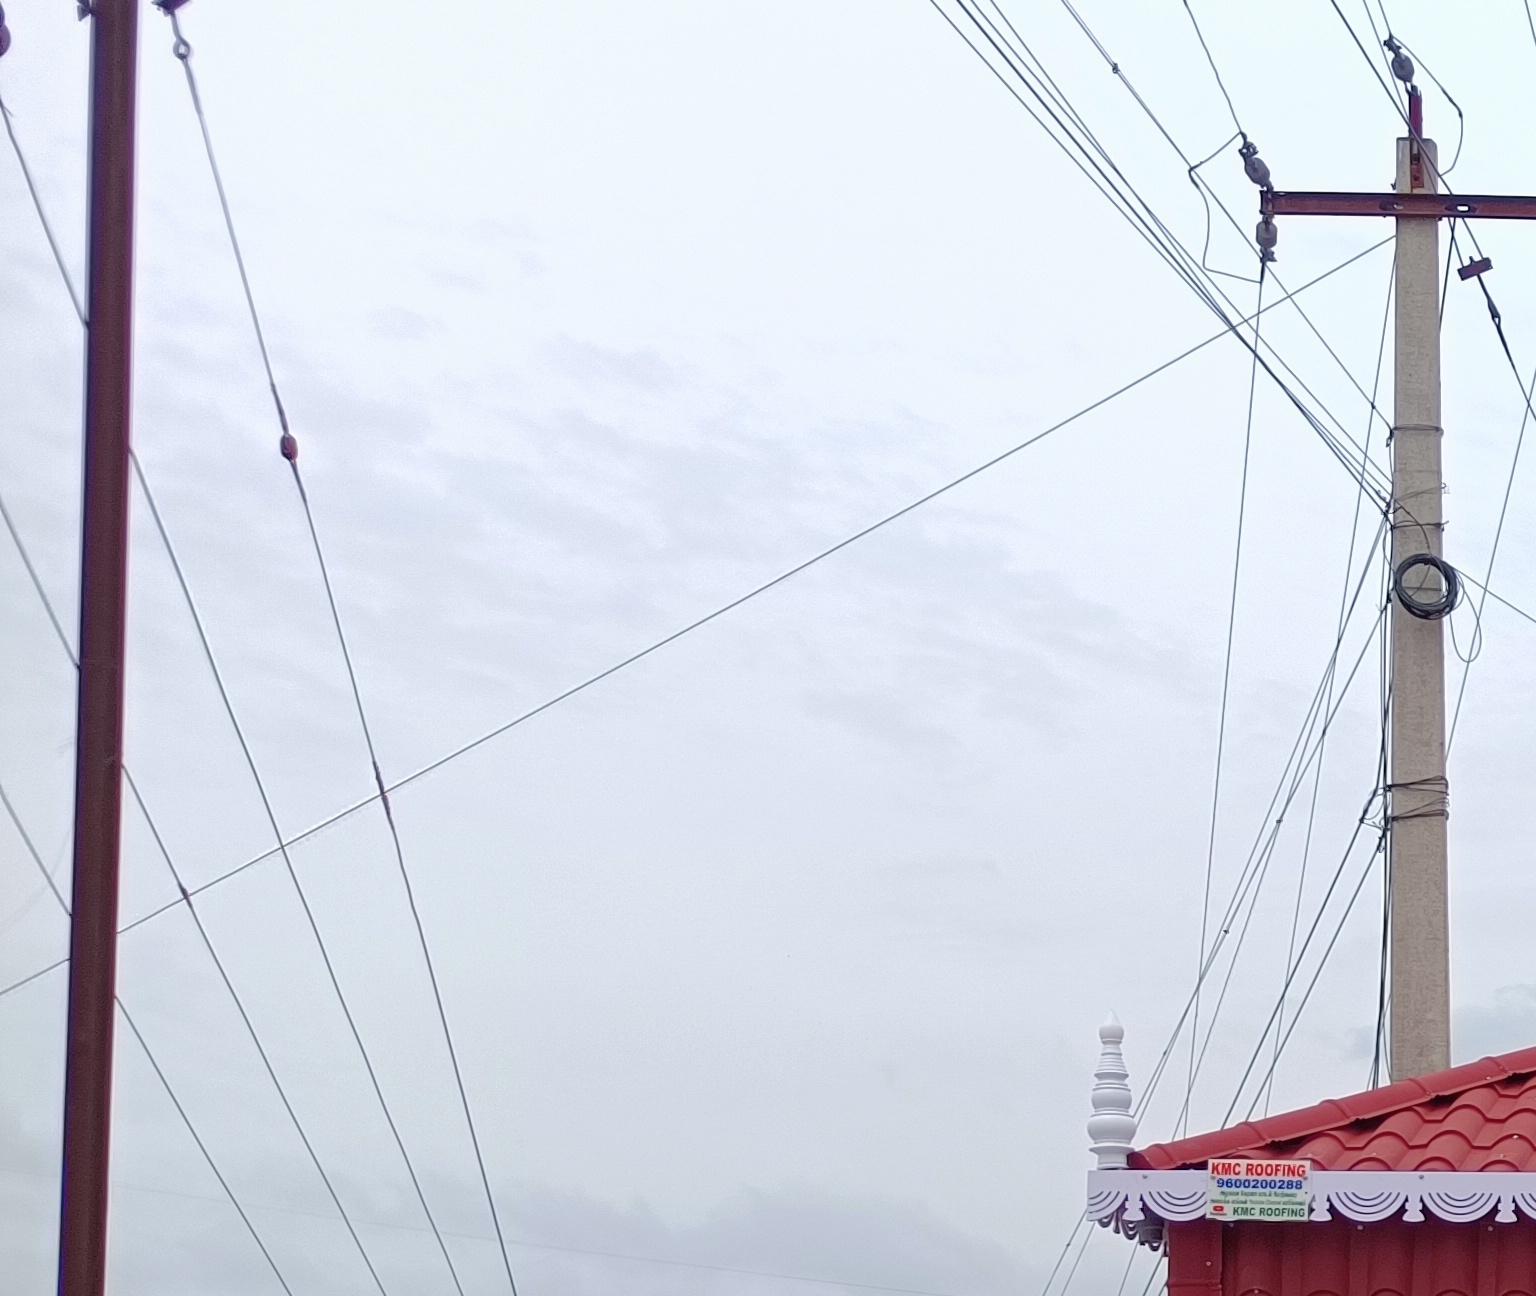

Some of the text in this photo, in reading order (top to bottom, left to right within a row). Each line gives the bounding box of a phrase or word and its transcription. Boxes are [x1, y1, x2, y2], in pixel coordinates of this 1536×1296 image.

[1211, 1162, 1306, 1177] KMC ROOFING
[1216, 1178, 1303, 1190] 9600200288
[1233, 1207, 1256, 1216] KMC
[1259, 1207, 1305, 1217] ROOFING
